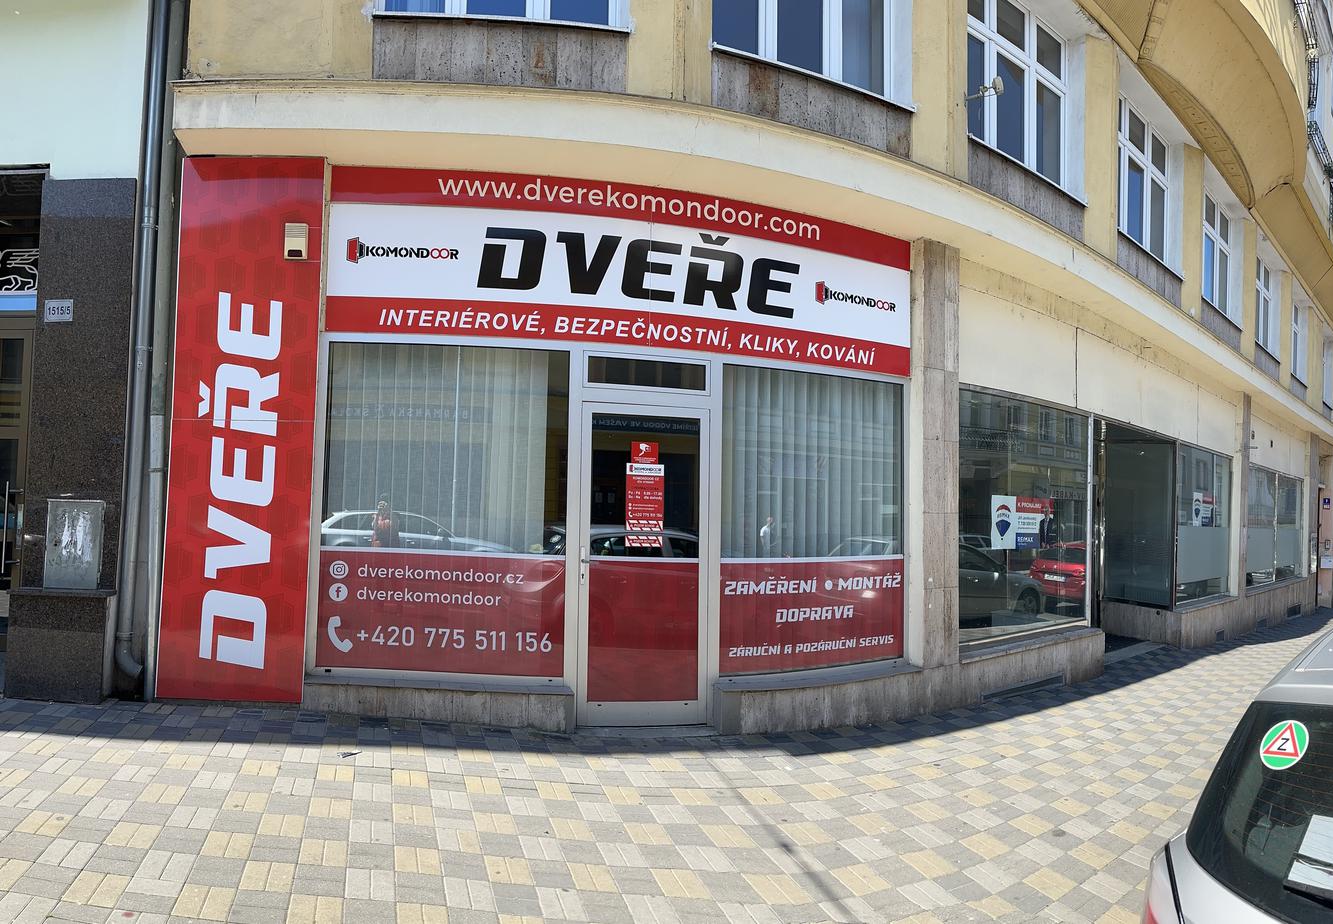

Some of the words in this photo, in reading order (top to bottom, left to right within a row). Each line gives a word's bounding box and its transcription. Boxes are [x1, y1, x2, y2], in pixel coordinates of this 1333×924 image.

[438, 177, 821, 241] www.dverekomondoor.com
[365, 245, 459, 261] KOMONDOOR
[476, 227, 801, 319] DVEŘE
[47, 306, 71, 316] 1515/5
[829, 290, 896, 313] KOMONDOOR
[379, 308, 546, 334] INTERIÉROVÉ,
[554, 317, 732, 349] BEZPEČNOSTNÍ,
[739, 333, 801, 358] KLIKY,
[807, 340, 876, 366] KOVÁNÍ
[198, 291, 282, 670] DVEŘE
[357, 564, 524, 585] dverekomondoor.cz
[724, 576, 817, 595] ZAMĚŘENÍ
[838, 572, 902, 590] MONTÁŽ
[356, 586, 501, 607] dverekomondoor
[775, 604, 854, 623] DOPRAVA
[357, 625, 415, 647] +420
[424, 627, 465, 649] 775
[475, 630, 506, 651] 511
[515, 631, 552, 653] 156
[728, 642, 781, 657] ZÁRUČNÍ
[784, 644, 792, 654] A
[795, 636, 857, 653] POZÁRUČNÍ
[859, 634, 894, 647] SERVIS
[1277, 738, 1289, 751] Z
